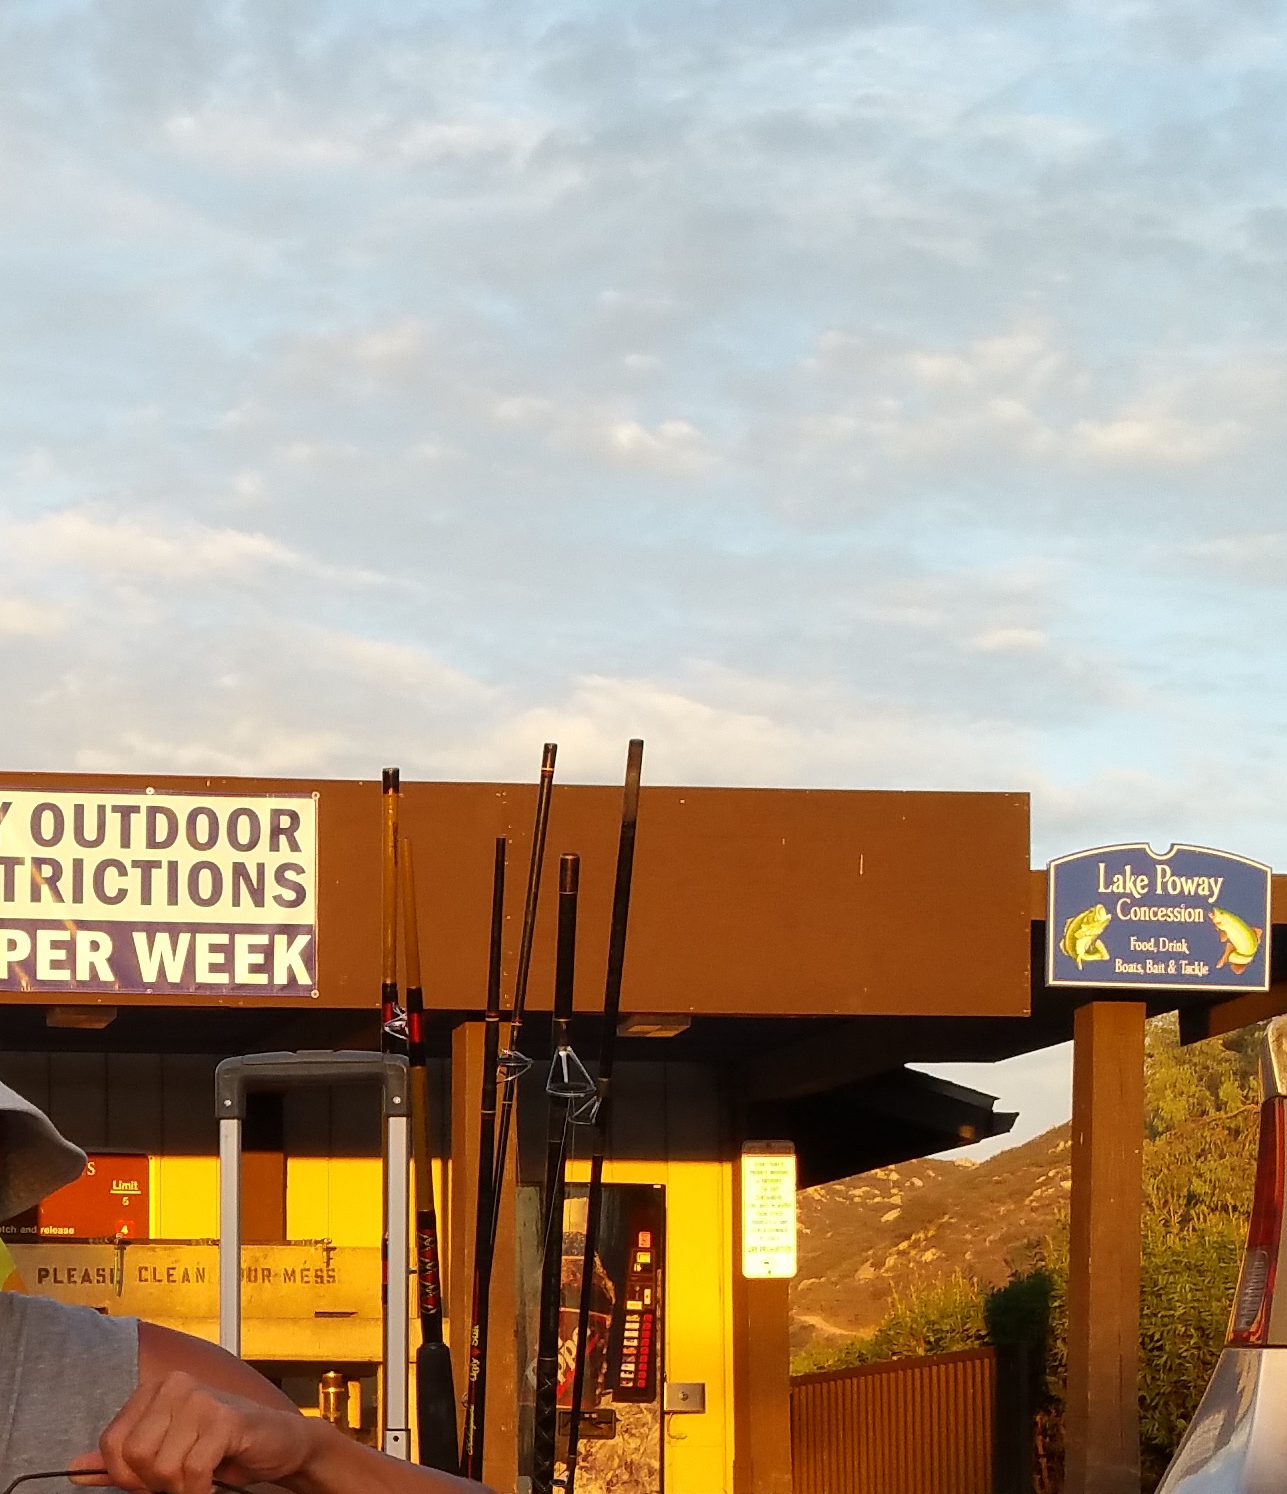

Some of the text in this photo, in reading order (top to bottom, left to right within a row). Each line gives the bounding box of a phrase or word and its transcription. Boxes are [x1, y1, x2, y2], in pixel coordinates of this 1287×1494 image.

[29, 803, 302, 853] OUTDOOR
[1098, 862, 1224, 903] Lake Poway
[1117, 898, 1204, 923] Concession
[1159, 937, 1190, 954] Drink
[131, 931, 313, 984] WEEK
[1146, 959, 1166, 974] Bait
[1168, 959, 1177, 975] &
[1179, 960, 1210, 977] Tackle
[112, 1180, 138, 1191] Limit
[20, 1225, 37, 1234] and
[40, 1225, 75, 1235] release
[138, 1266, 206, 1283] CLEAN
[283, 1267, 336, 1284] MESS
